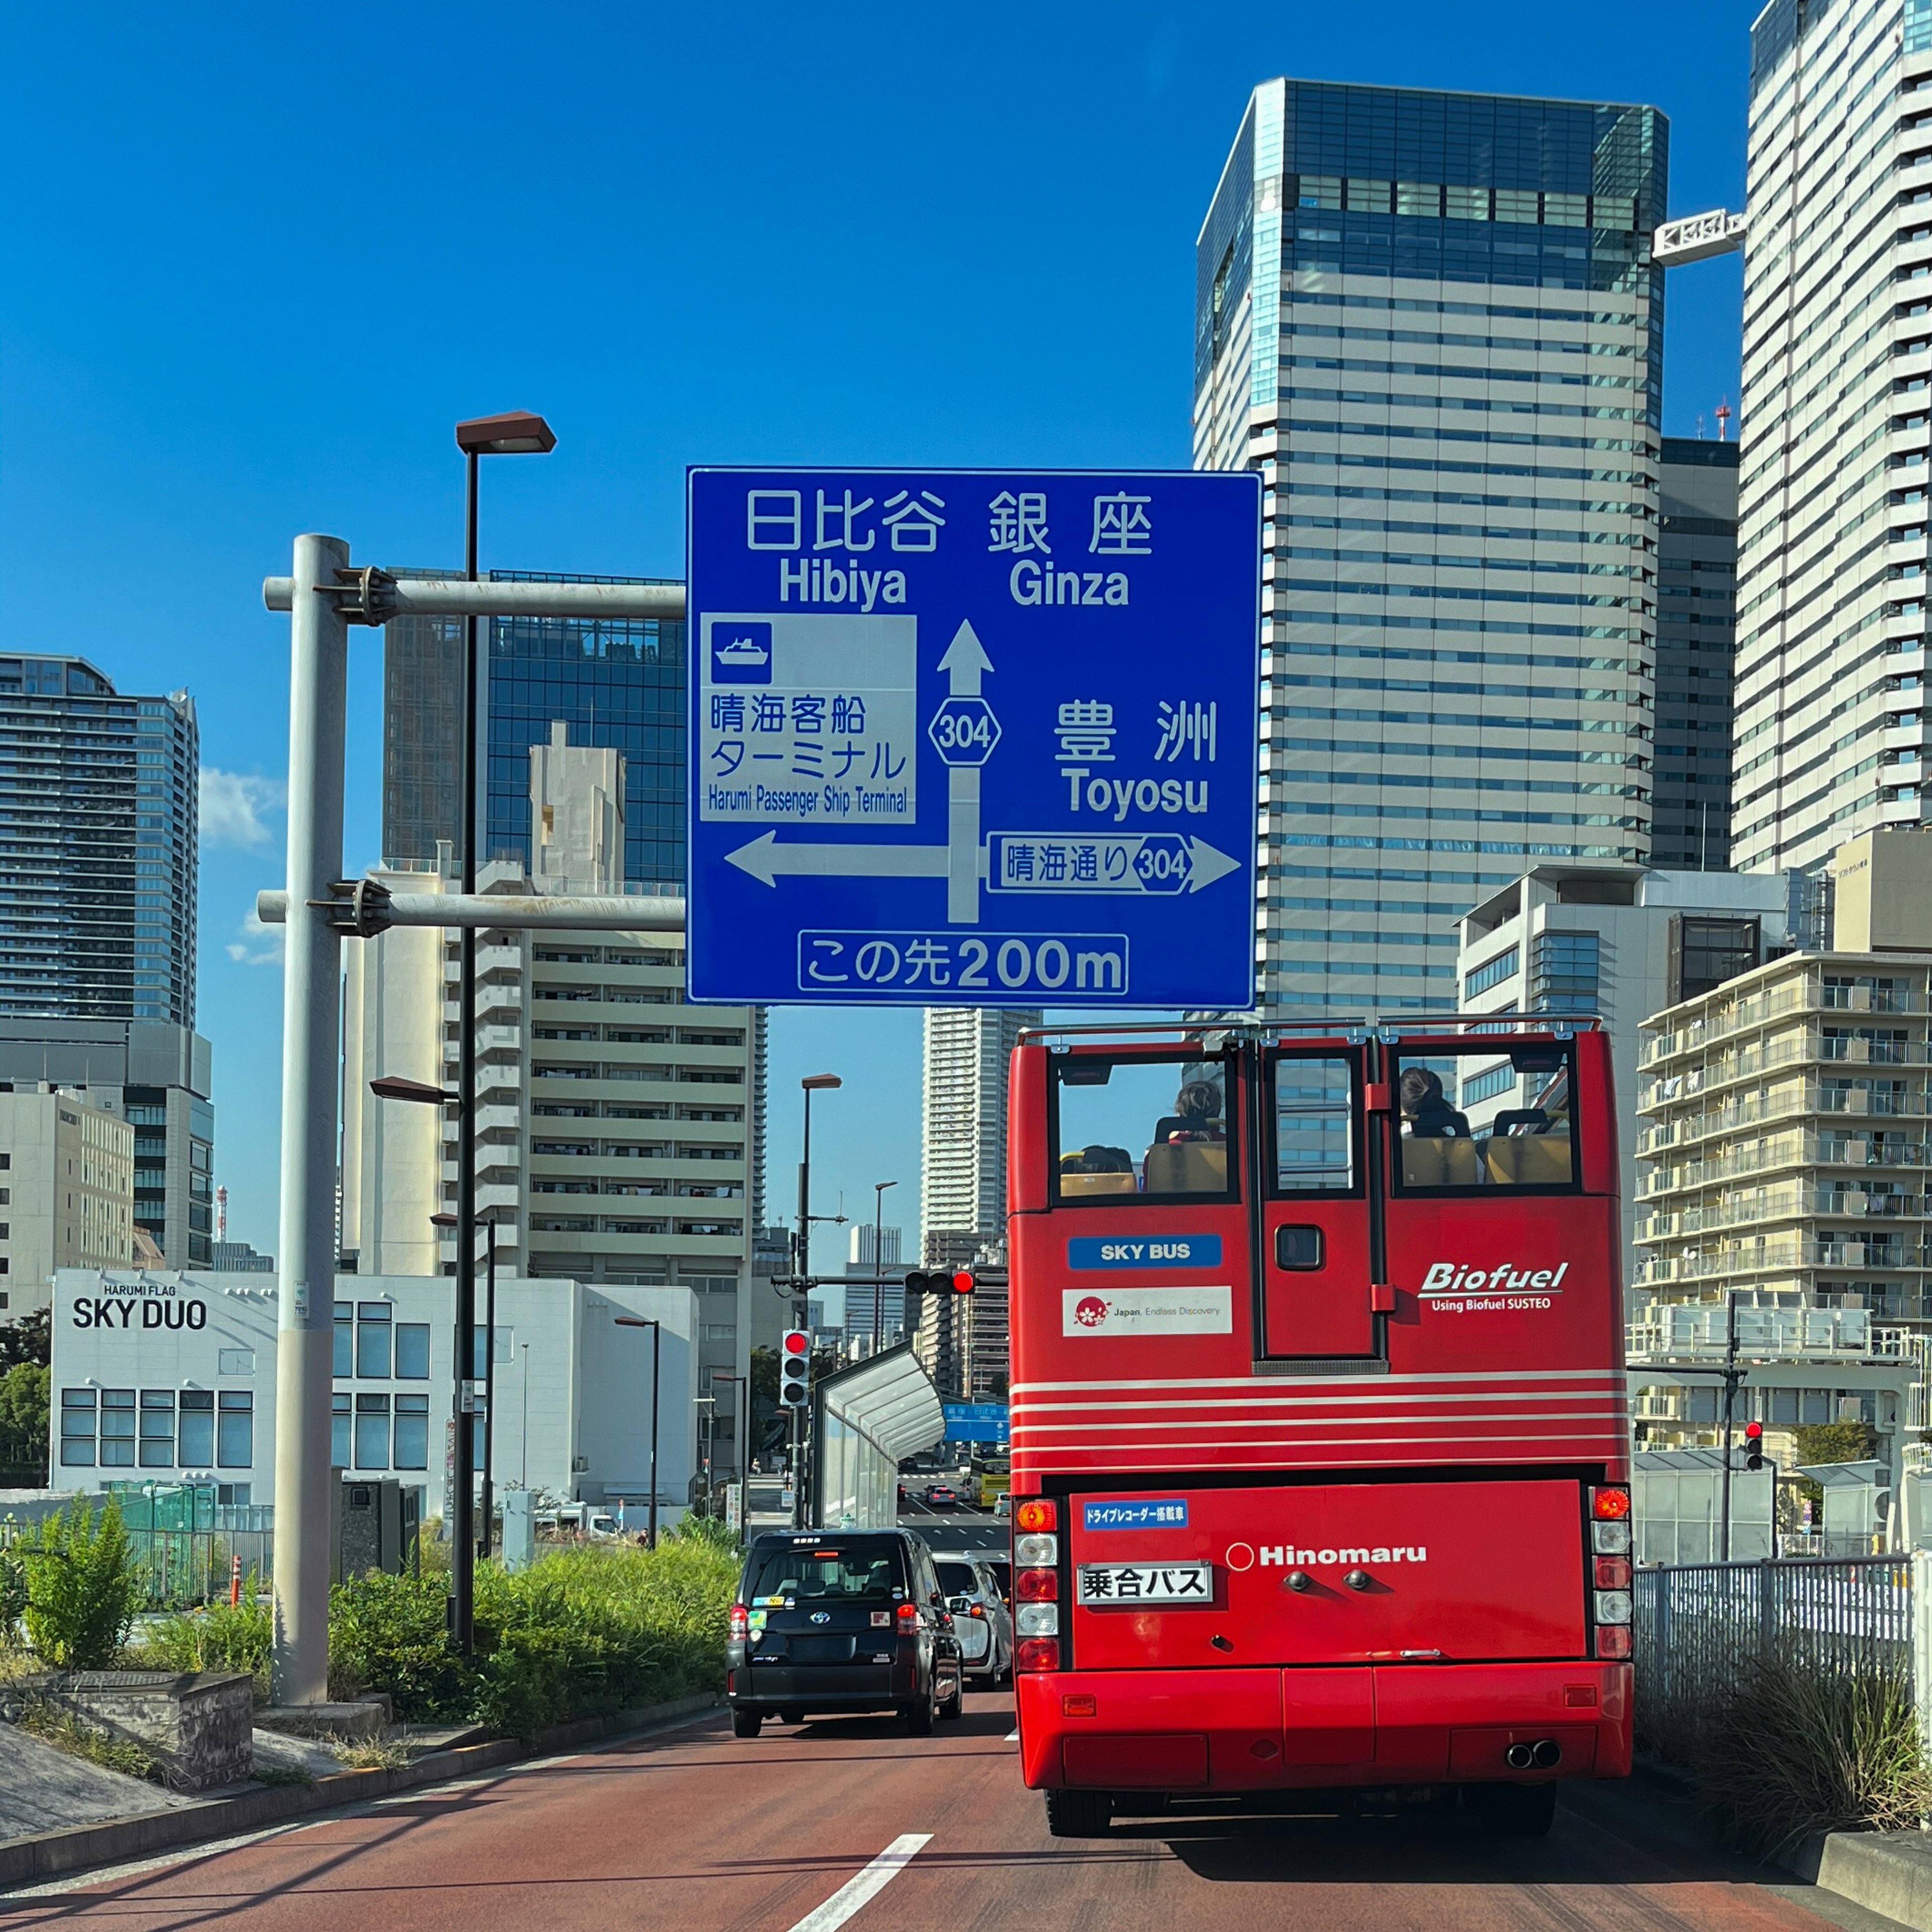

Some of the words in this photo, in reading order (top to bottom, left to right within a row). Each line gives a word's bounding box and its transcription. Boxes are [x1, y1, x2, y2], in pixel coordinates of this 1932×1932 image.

[748, 489, 946, 552] 日比谷
[780, 558, 906, 612] Hibiya
[1010, 559, 1129, 605] Ginza
[711, 692, 866, 734] 晴海客船
[939, 715, 991, 749] 304
[711, 740, 906, 779] ターミナル
[709, 783, 752, 812] Harumi
[756, 784, 819, 818] Passenger
[824, 784, 850, 818] Ship
[855, 785, 907, 813] Terminal
[1061, 768, 1208, 822] Toyosu
[1007, 843, 1128, 881] 晴海通り
[1139, 848, 1186, 880] 304
[1101, 1245, 1144, 1260] SKY
[1150, 1243, 1190, 1259] BUS
[104, 1284, 146, 1296] HARUMI
[148, 1285, 176, 1297] FLAG
[1421, 1262, 1569, 1290] Biofuel
[72, 1298, 137, 1329] SKY
[142, 1300, 207, 1330] DUO
[1145, 1307, 1177, 1316] Endless
[1431, 1300, 1464, 1313] Using
[1466, 1298, 1505, 1310] Biofuel
[1507, 1297, 1551, 1309] SUSTEO
[1259, 1545, 1427, 1566] Hinomaru
[1084, 1568, 1205, 1598] 乗合バス
